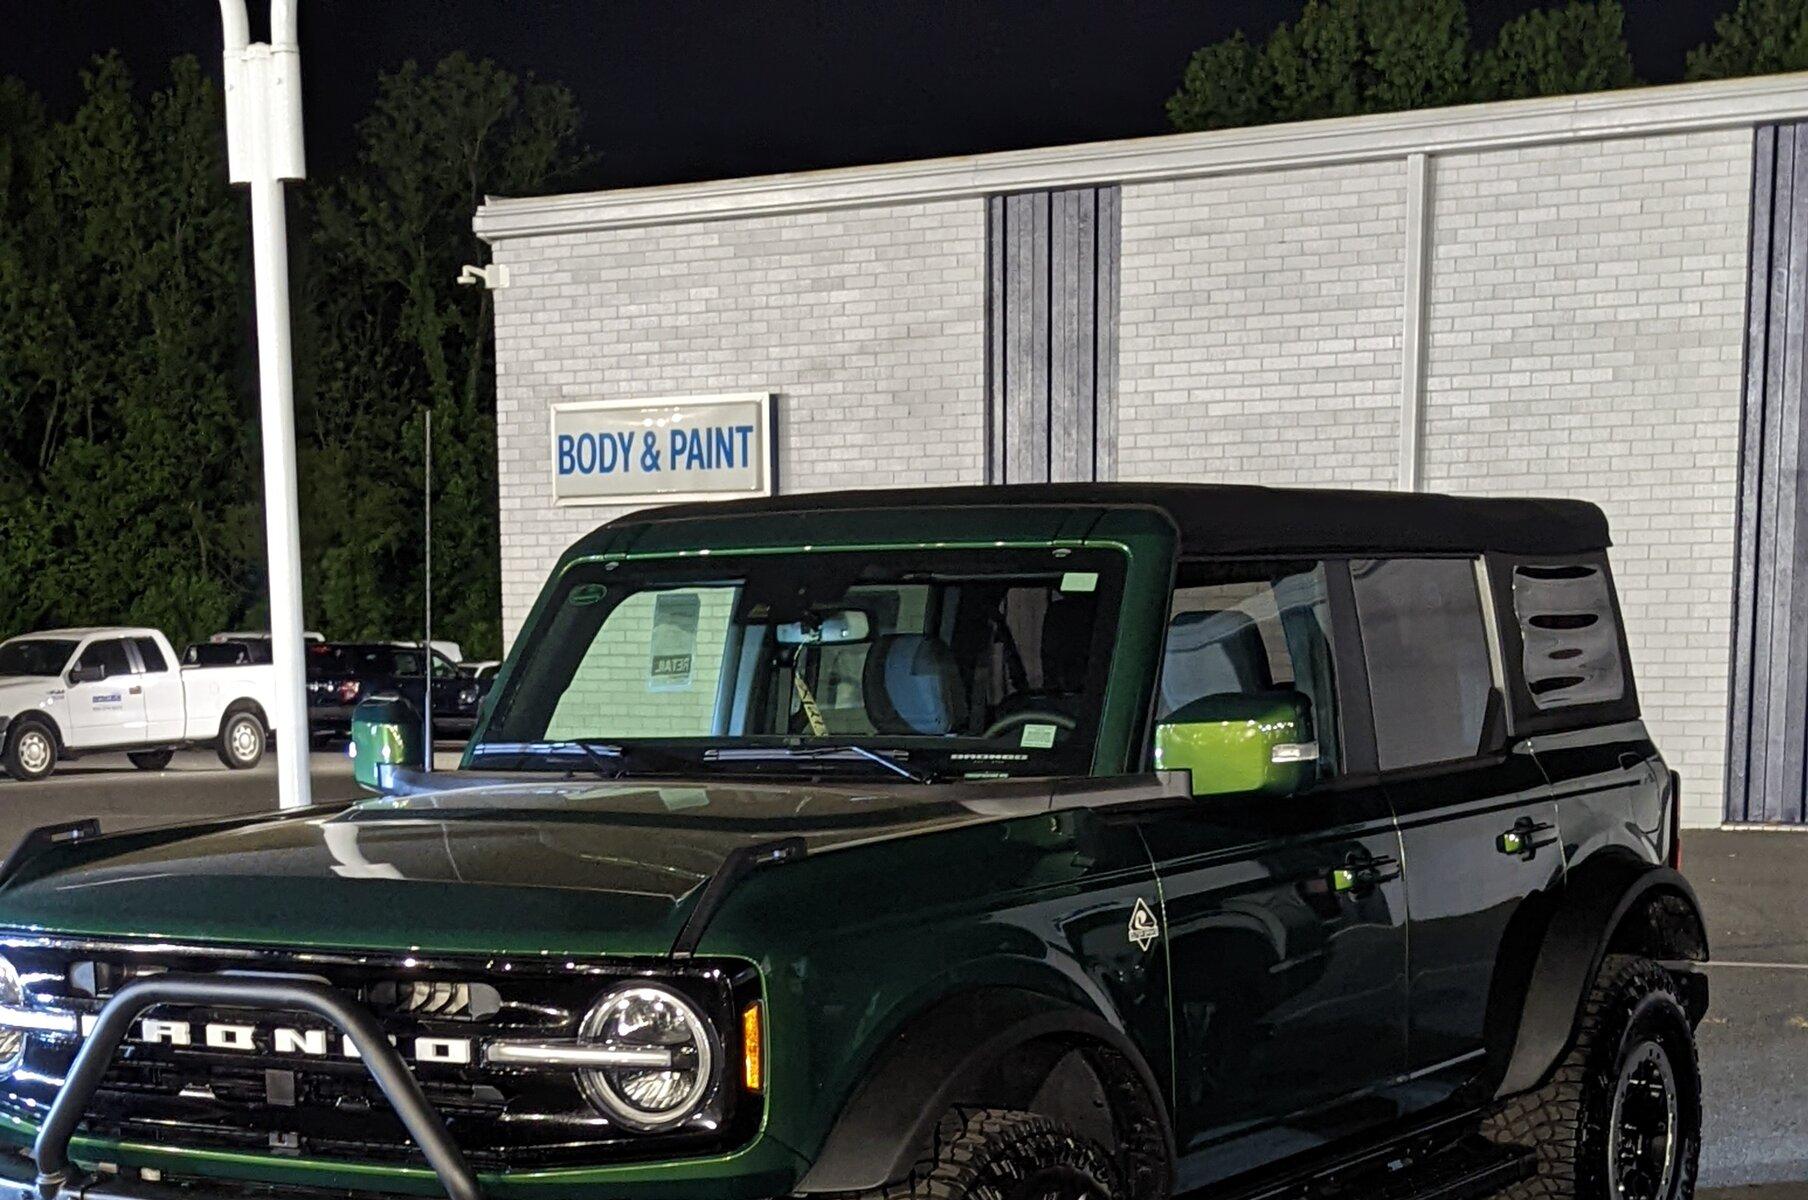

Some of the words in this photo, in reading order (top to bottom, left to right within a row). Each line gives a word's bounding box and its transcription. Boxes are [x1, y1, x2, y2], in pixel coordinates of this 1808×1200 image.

[558, 431, 634, 475] BODY
[641, 430, 661, 473] &
[670, 425, 753, 471] PAINT
[82, 1013, 471, 1064] RONO
